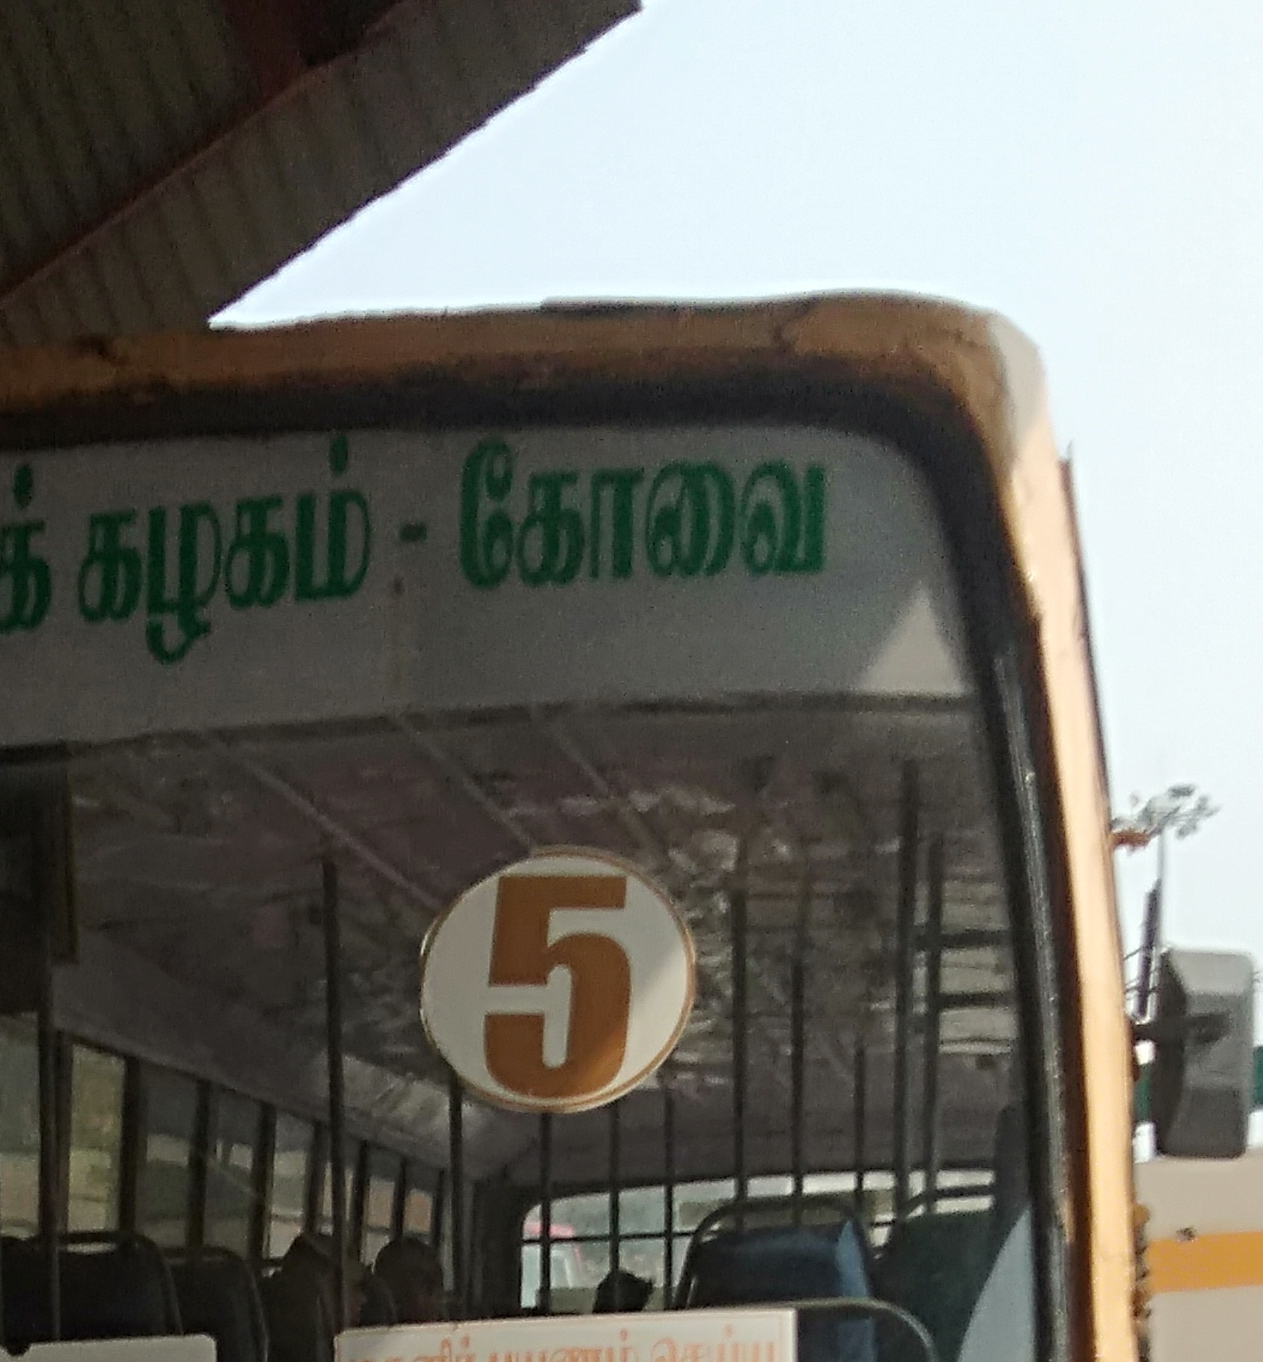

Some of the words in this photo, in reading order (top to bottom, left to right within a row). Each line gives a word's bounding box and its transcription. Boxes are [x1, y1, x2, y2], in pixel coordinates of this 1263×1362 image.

[77, 435, 373, 665] கழகம்
[459, 437, 828, 590] கோவை
[483, 874, 632, 1099] 5
